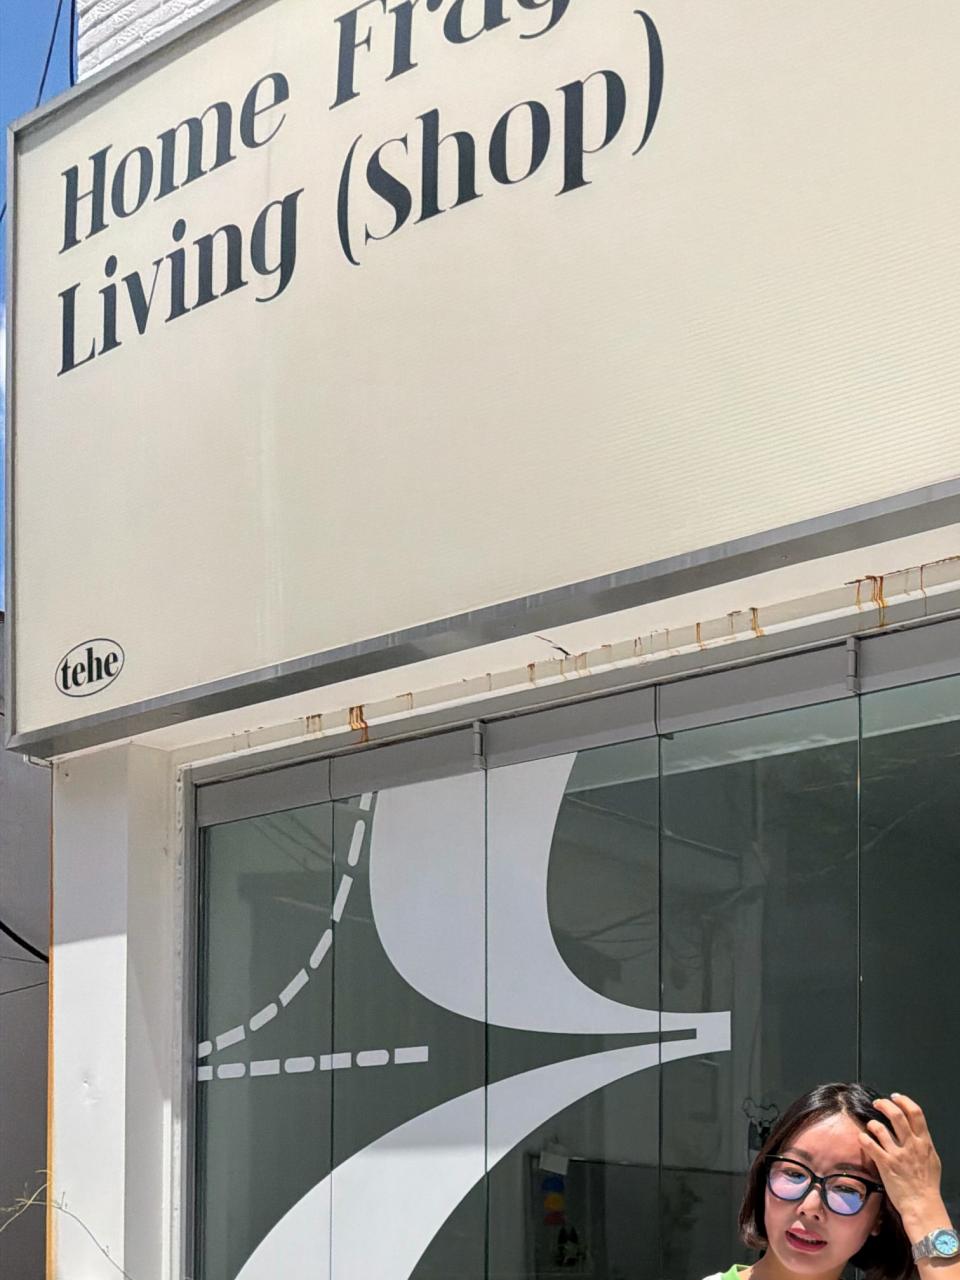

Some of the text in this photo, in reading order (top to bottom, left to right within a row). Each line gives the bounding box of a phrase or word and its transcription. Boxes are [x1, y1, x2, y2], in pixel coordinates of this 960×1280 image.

[57, 9, 664, 376] Living (Shop)
[59, 71, 290, 254] Home
[61, 646, 119, 690] tehe
